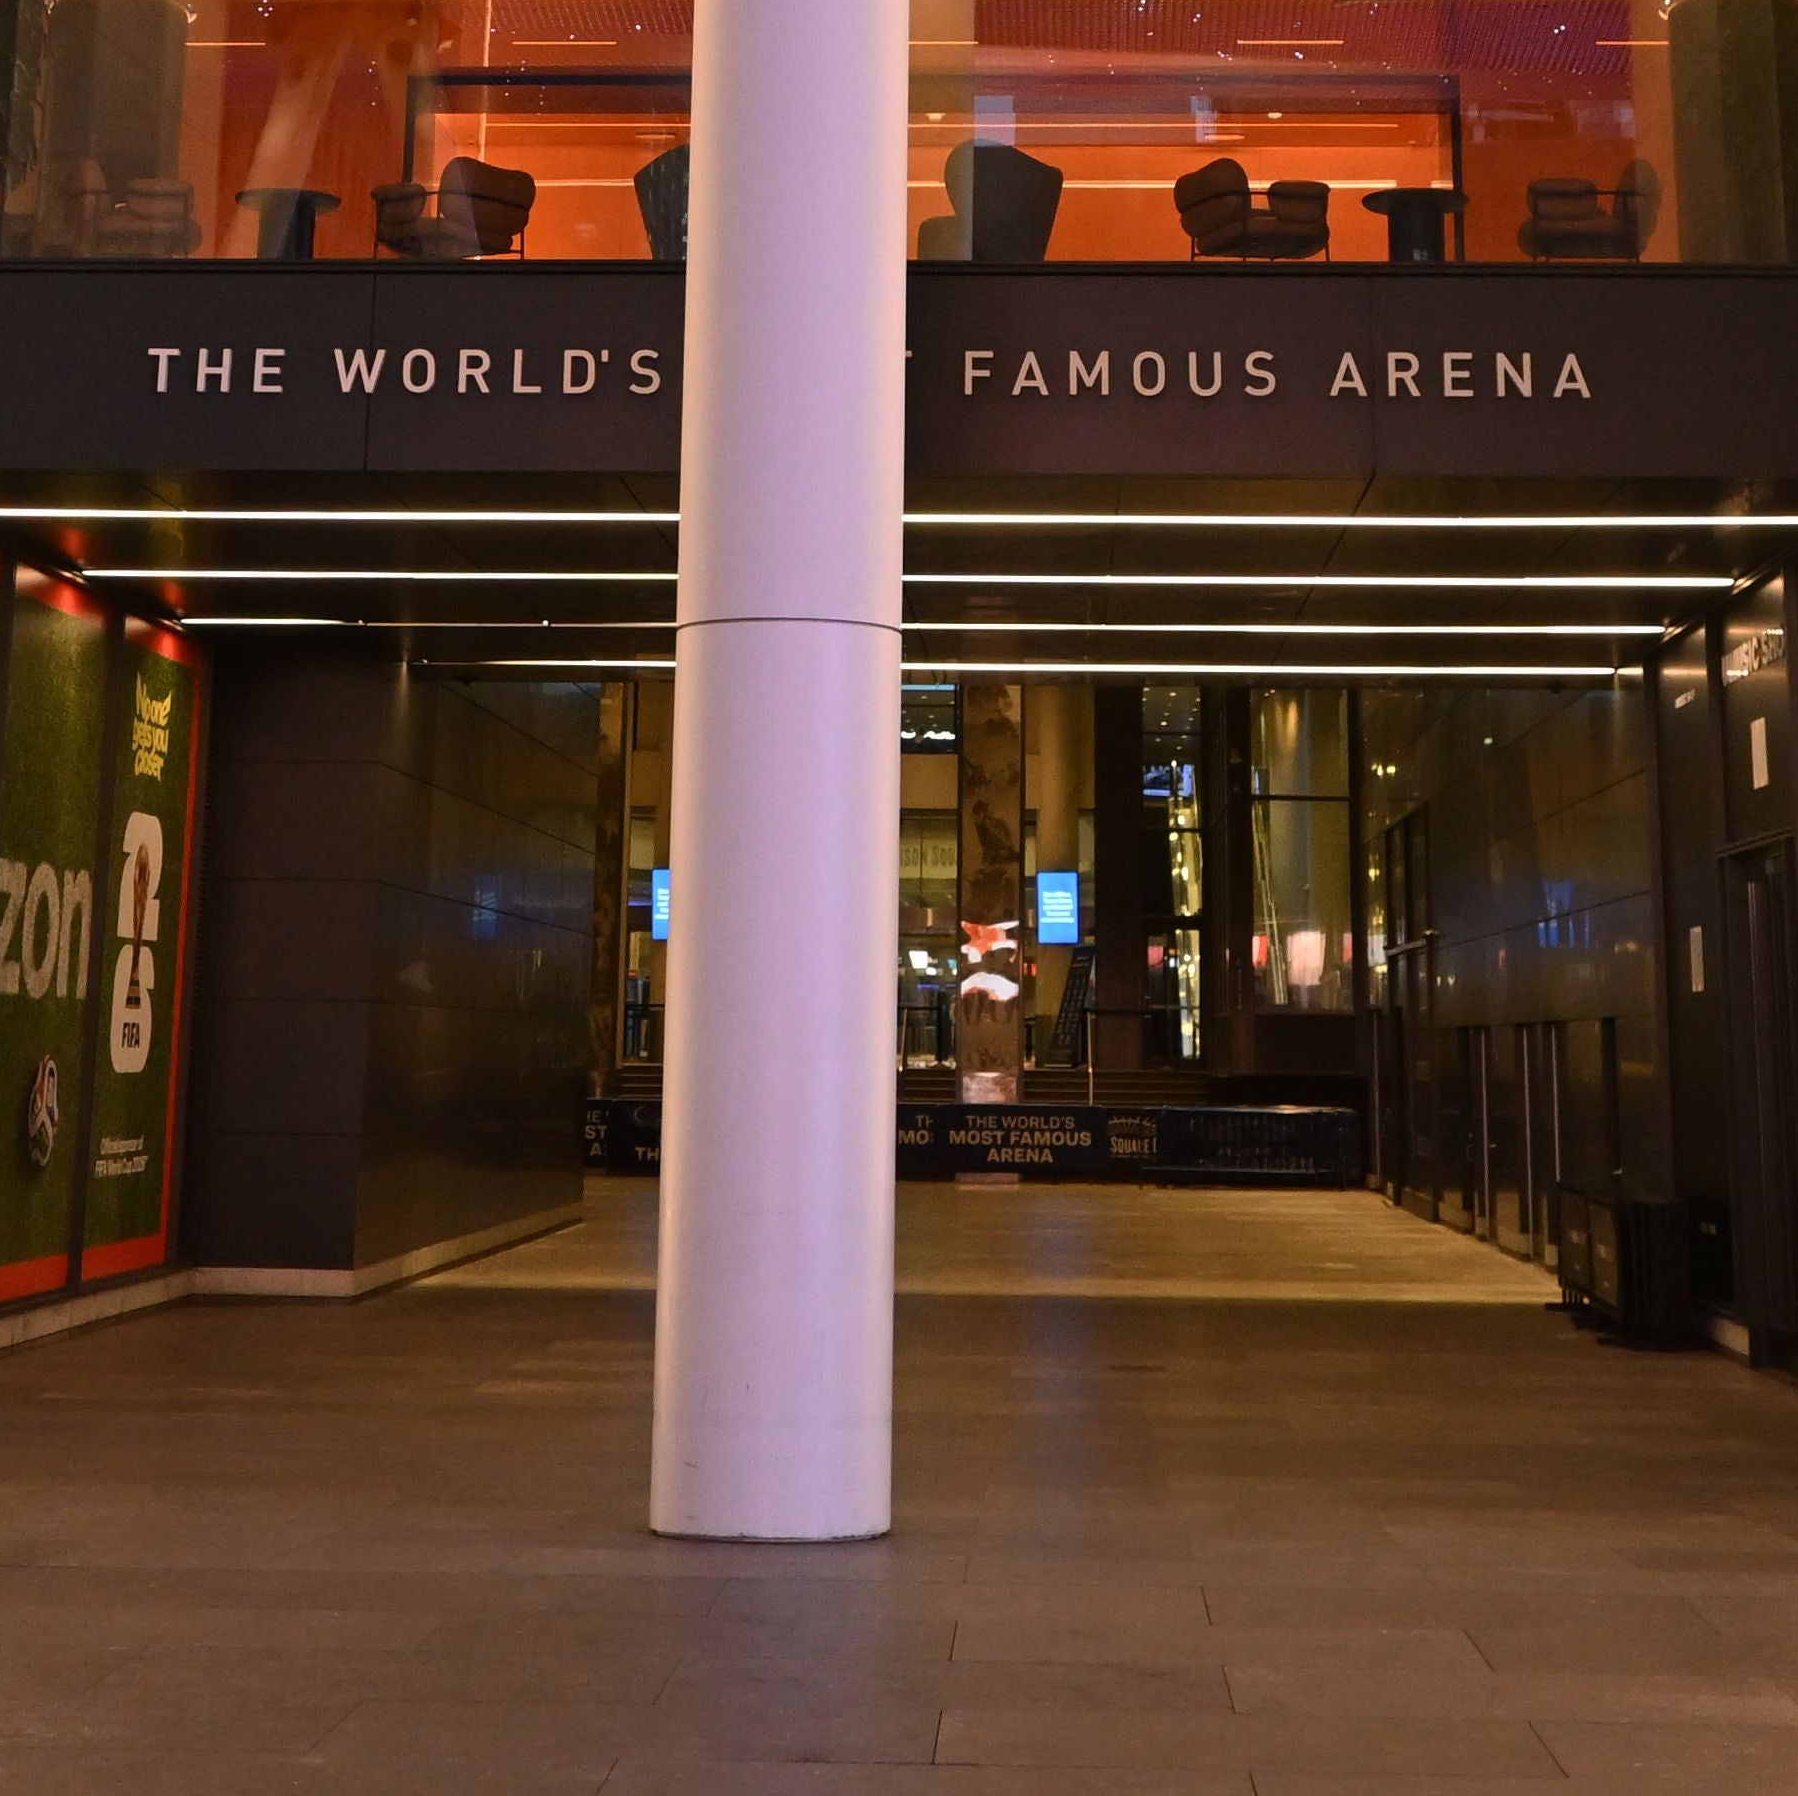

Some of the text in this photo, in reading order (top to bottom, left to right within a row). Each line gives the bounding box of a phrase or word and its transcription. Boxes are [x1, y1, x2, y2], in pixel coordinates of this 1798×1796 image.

[146, 347, 1592, 399] THE WORLD'S FAMOUS ARENA
[121, 1021, 141, 1049] FIFA
[966, 1115, 1076, 1130] THE WORLD'S
[948, 1130, 1093, 1147] MOST FAMOUS
[986, 1147, 1056, 1164] ARENA
